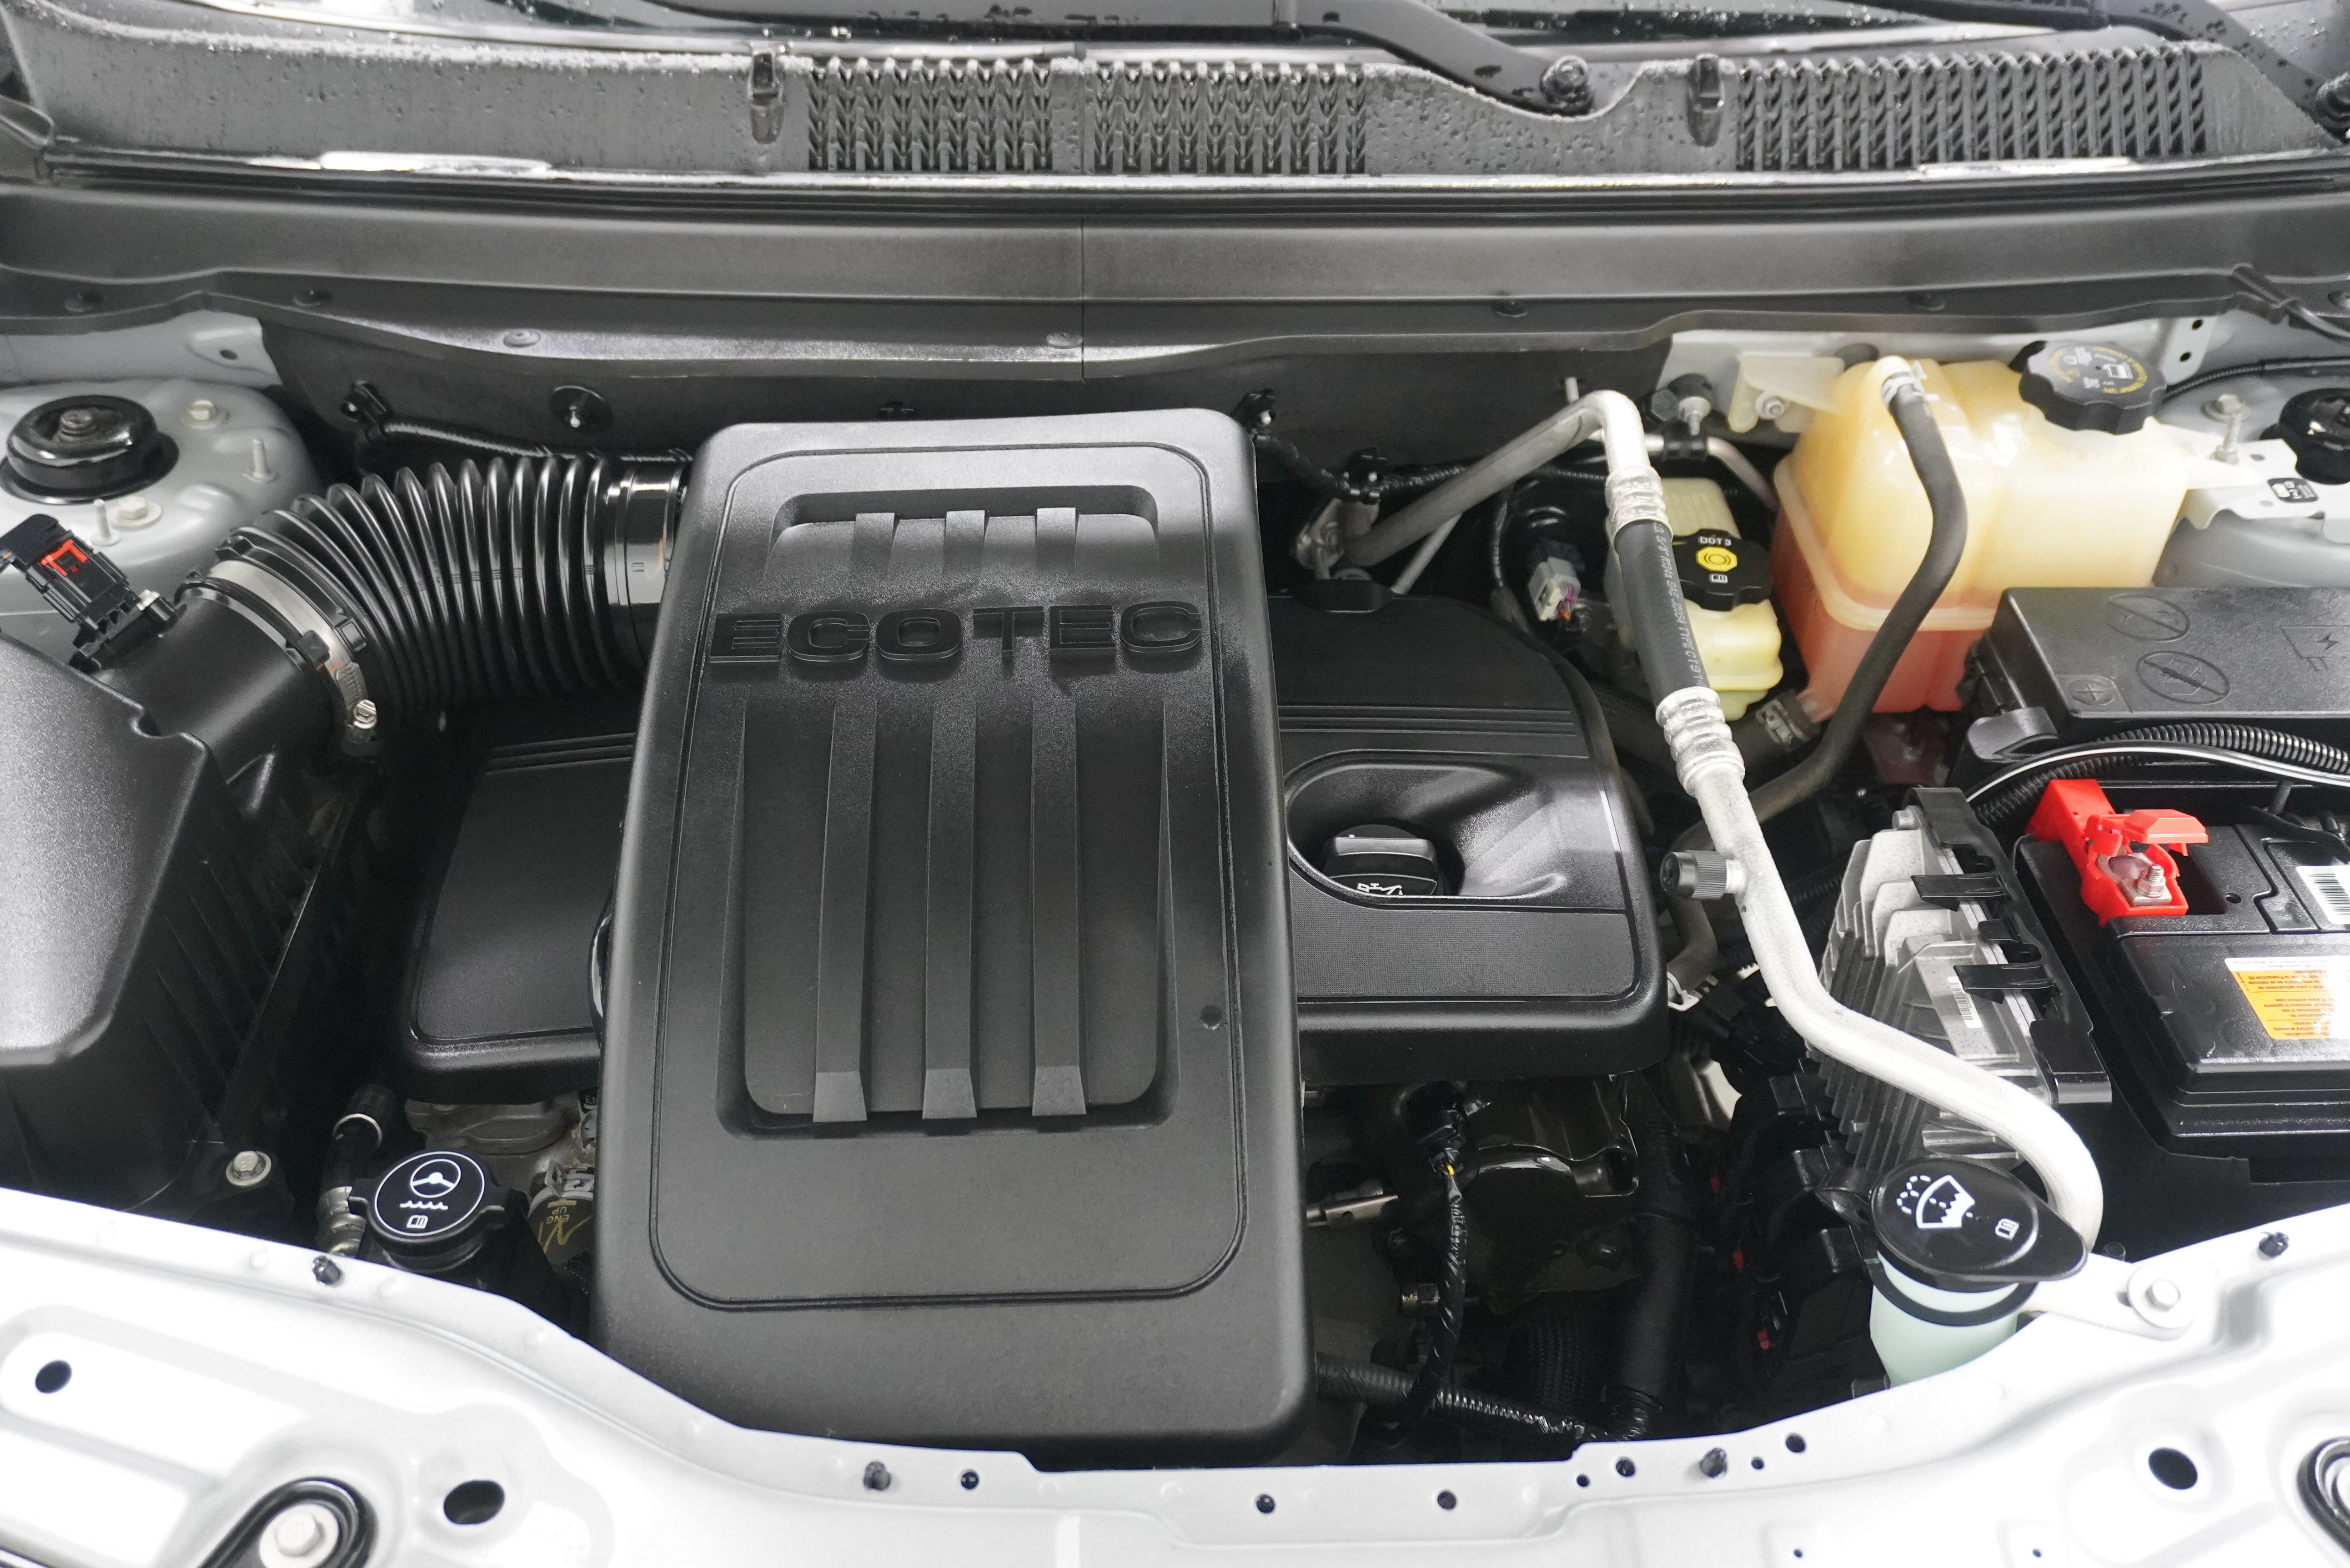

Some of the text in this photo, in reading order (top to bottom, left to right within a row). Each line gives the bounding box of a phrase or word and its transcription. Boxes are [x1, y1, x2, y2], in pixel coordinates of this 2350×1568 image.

[1657, 535, 1669, 556] 5/8"
[1700, 536, 1732, 546] DOT 3
[1666, 580, 1679, 598] SAE
[1671, 598, 1687, 624] J2064
[709, 600, 1202, 663] ECOTEC
[1679, 627, 1694, 650] TYPE
[546, 1214, 570, 1224] ENG
[552, 1206, 567, 1215] UP
